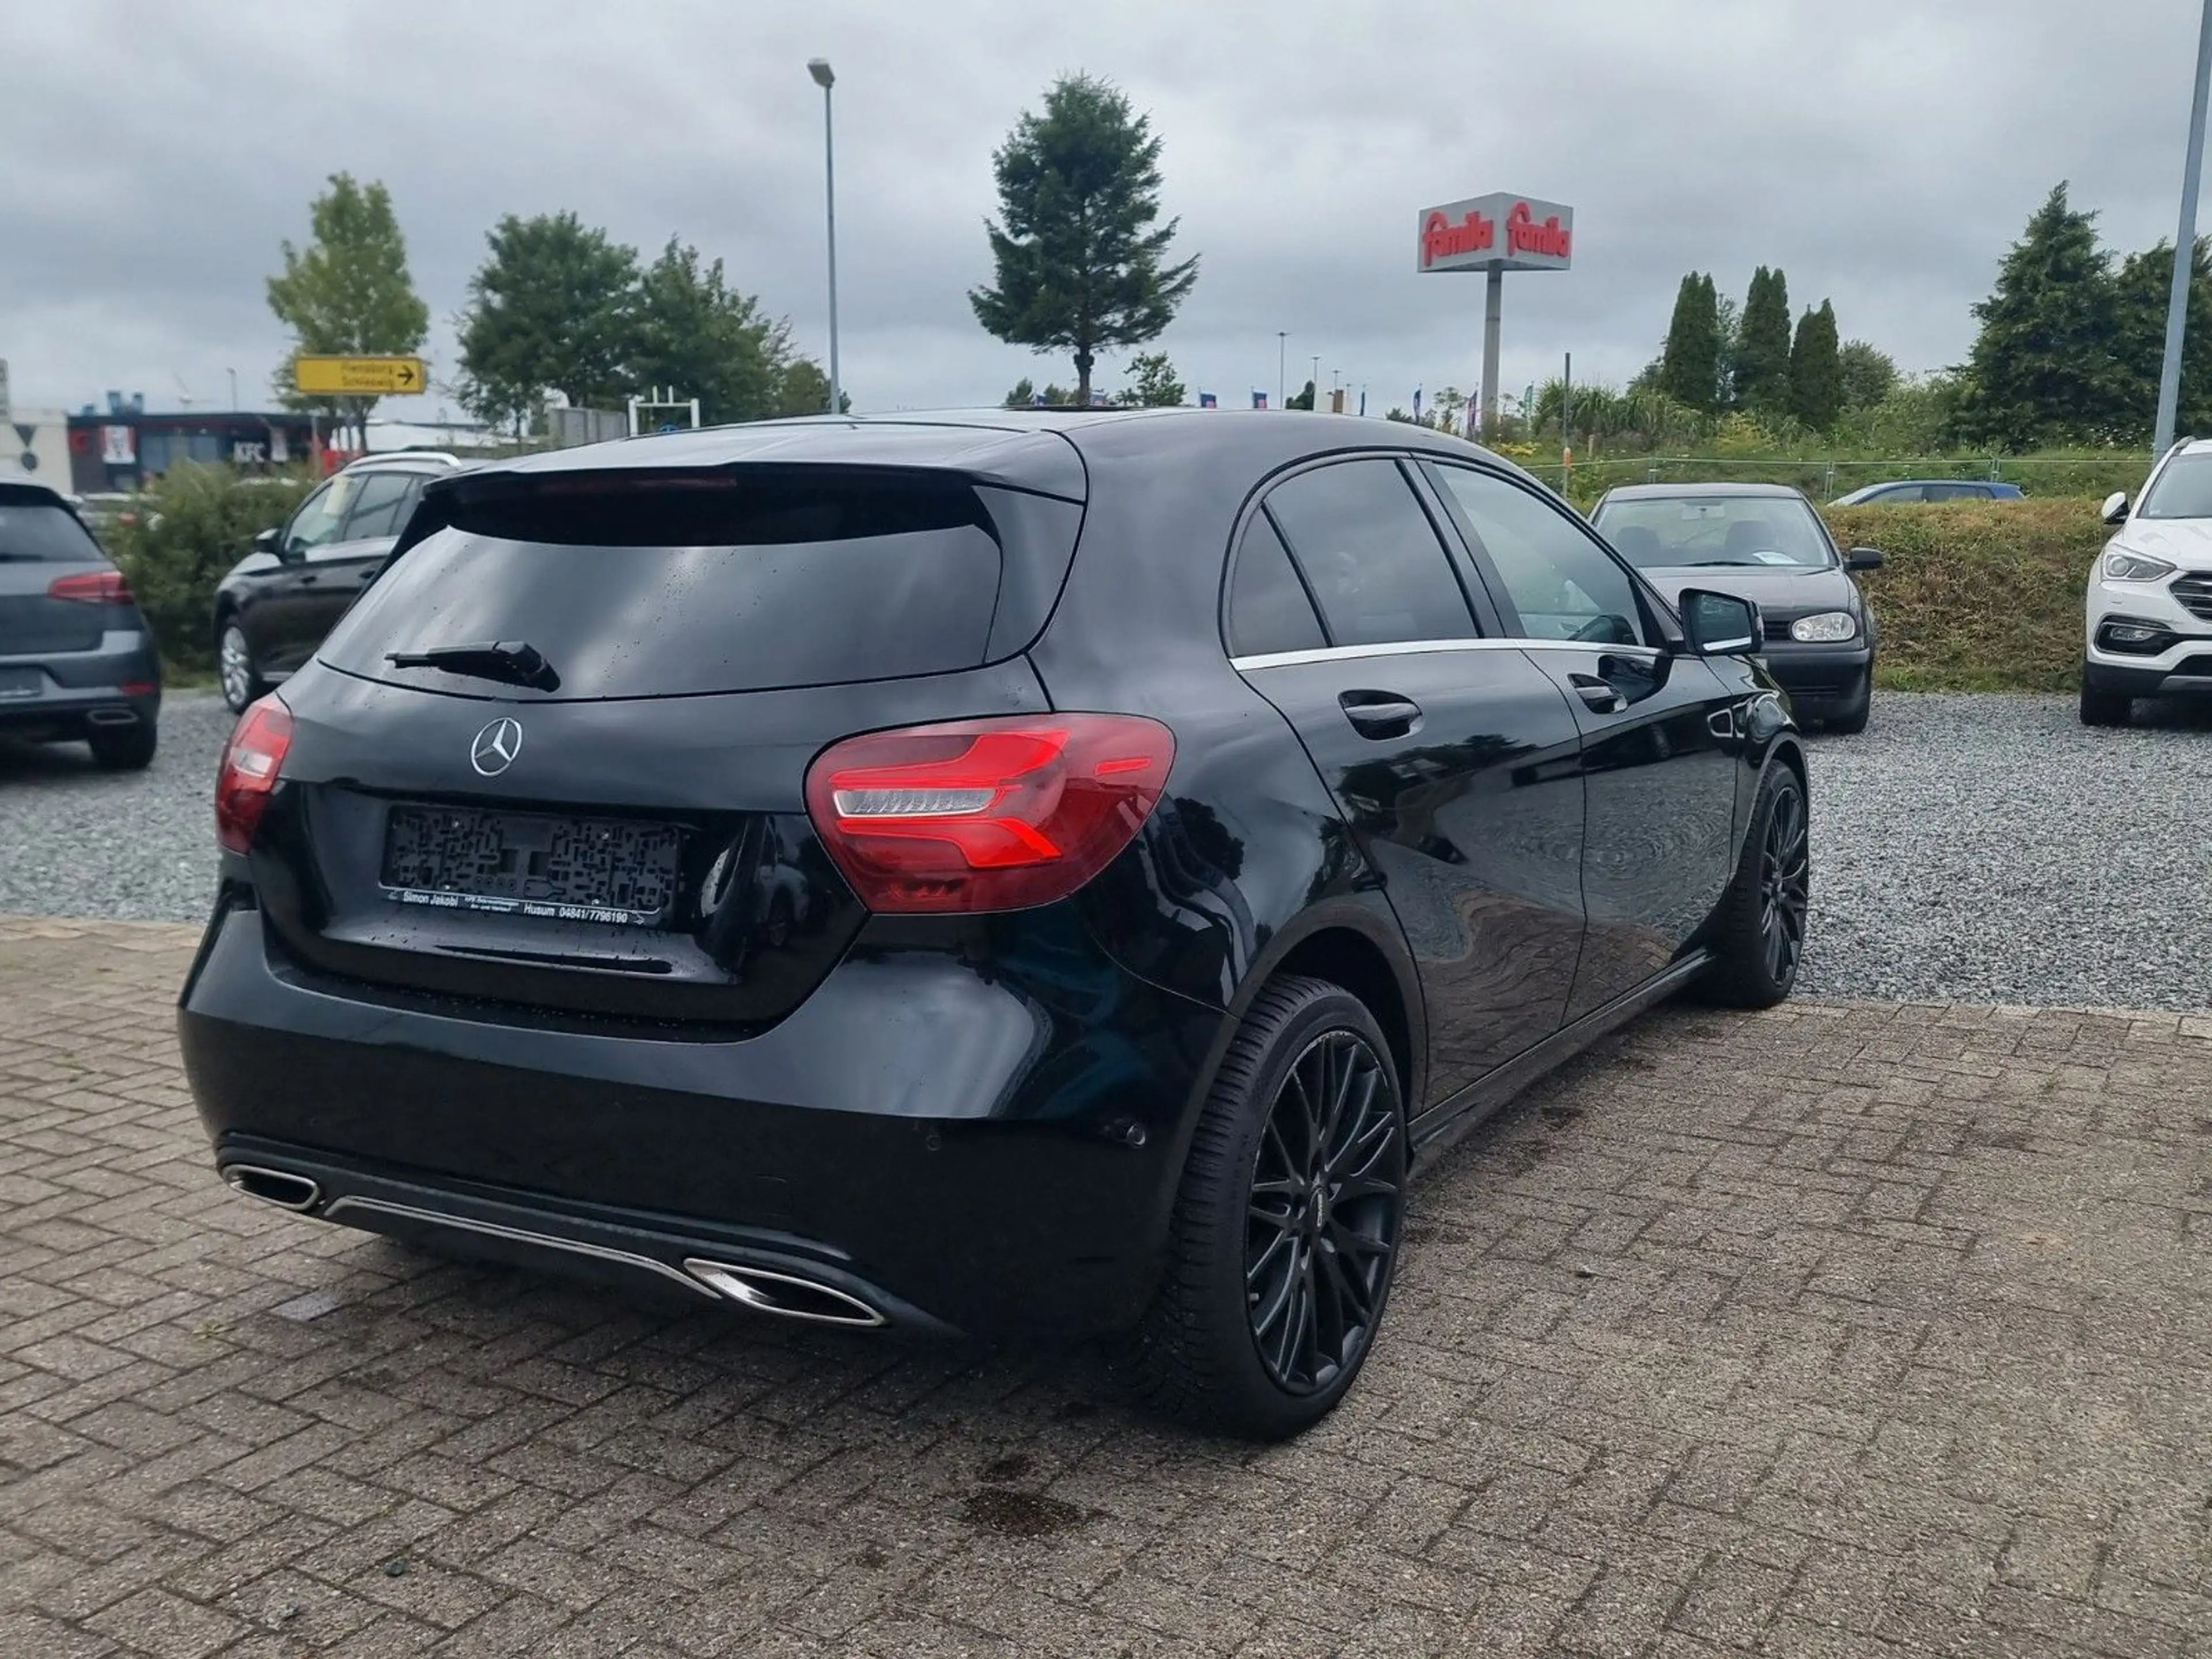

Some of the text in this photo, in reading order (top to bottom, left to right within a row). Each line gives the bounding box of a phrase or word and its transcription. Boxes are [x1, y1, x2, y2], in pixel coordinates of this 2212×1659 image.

[234, 441, 265, 463] KFC
[403, 891, 429, 904] Simon
[524, 902, 555, 916] Husum
